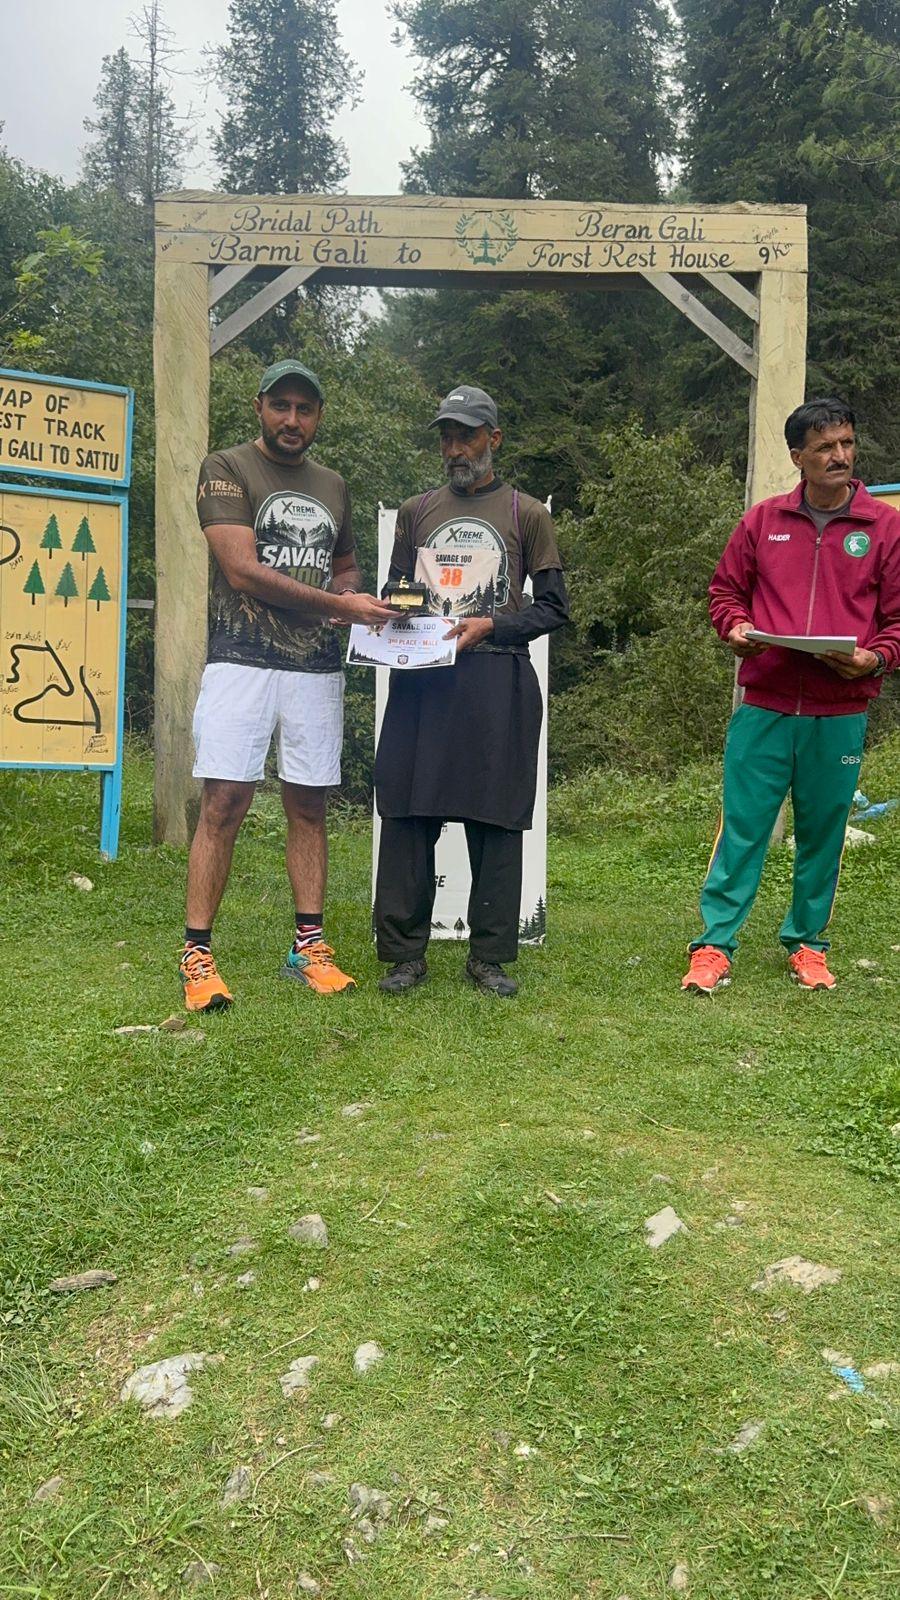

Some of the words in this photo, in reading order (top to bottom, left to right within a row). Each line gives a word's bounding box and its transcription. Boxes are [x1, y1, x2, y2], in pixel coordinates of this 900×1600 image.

[229, 205, 312, 232] Bridal
[320, 206, 384, 234] Path
[575, 211, 653, 240] Beran
[658, 214, 706, 242] Gali
[209, 233, 304, 262] Barmi
[310, 238, 369, 264] Gali
[393, 241, 422, 264] to
[527, 243, 593, 268] Forst
[598, 244, 657, 268] Rest
[669, 249, 736, 270] House
[759, 246, 770, 265] 9
[0, 387, 32, 408] AP
[45, 394, 70, 415] OF
[43, 417, 106, 442] TRACK
[8, 438, 43, 462] GALI
[50, 444, 70, 465] TO
[76, 447, 119, 473] SATTU
[281, 500, 316, 515] XTREME
[445, 526, 484, 544] XTREME
[261, 545, 330, 572] SAVAGE
[435, 554, 459, 563] SAVAGE
[460, 555, 472, 563] 100
[440, 567, 463, 586] 38
[392, 622, 420, 631] SAVAGE
